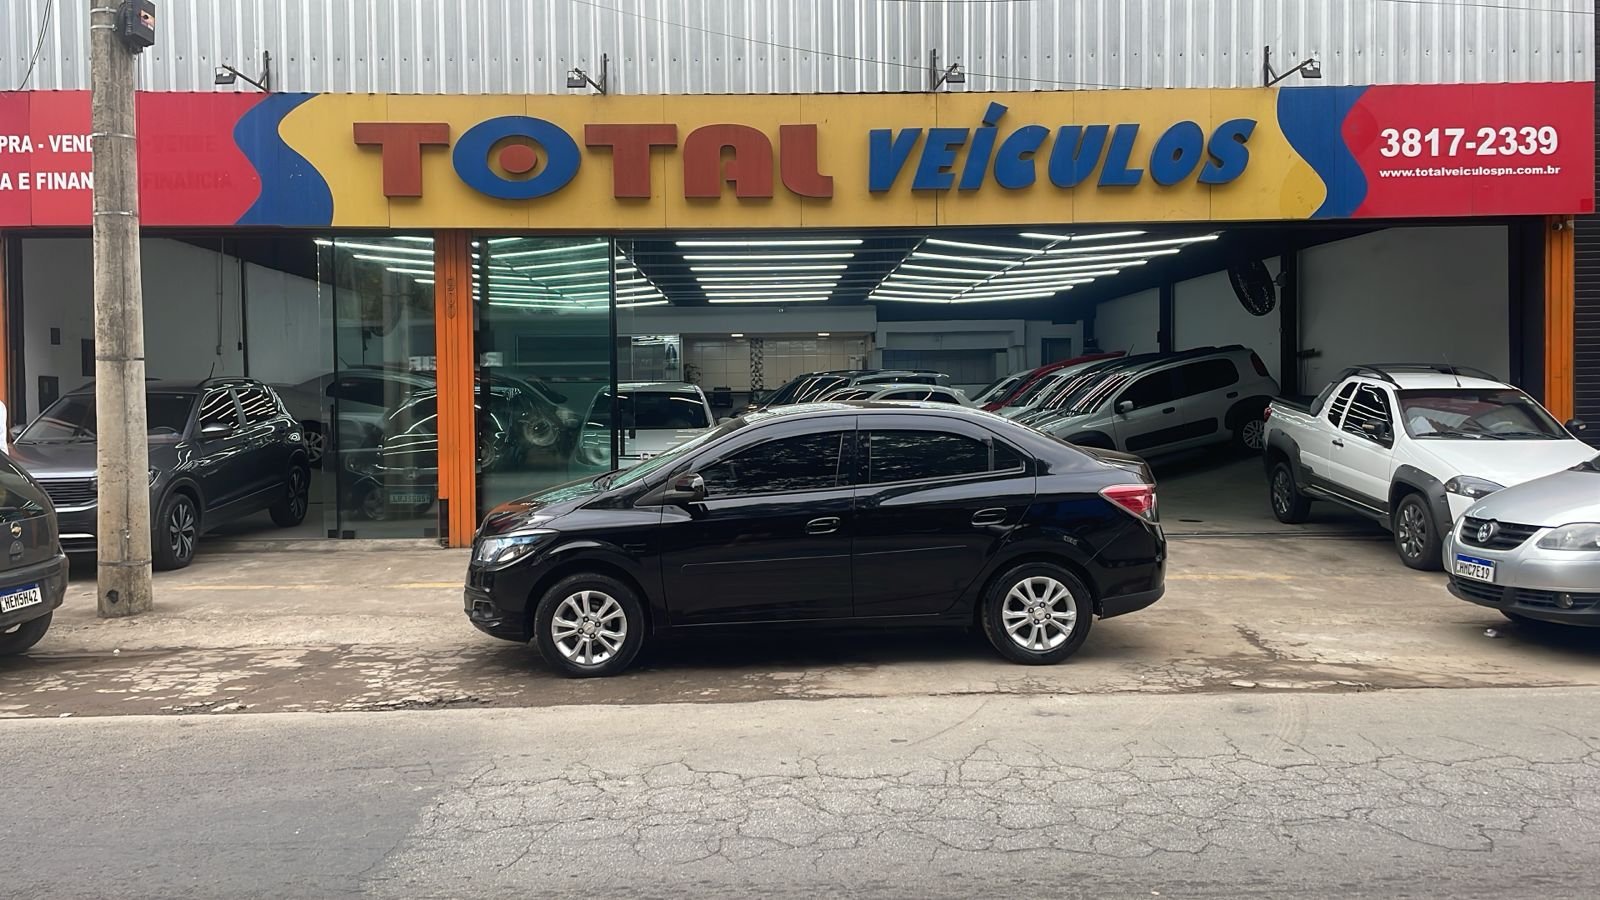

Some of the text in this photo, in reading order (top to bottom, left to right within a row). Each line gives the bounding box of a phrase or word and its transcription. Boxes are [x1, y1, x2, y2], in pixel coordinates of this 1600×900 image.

[353, 101, 1258, 200] TOTAL VEÍCULOS
[1380, 126, 1558, 157] 3817-2339
[1379, 165, 1561, 177] www.totalveiculospn.com.br
[18, 172, 30, 190] E
[4, 590, 38, 609] HEM5H42
